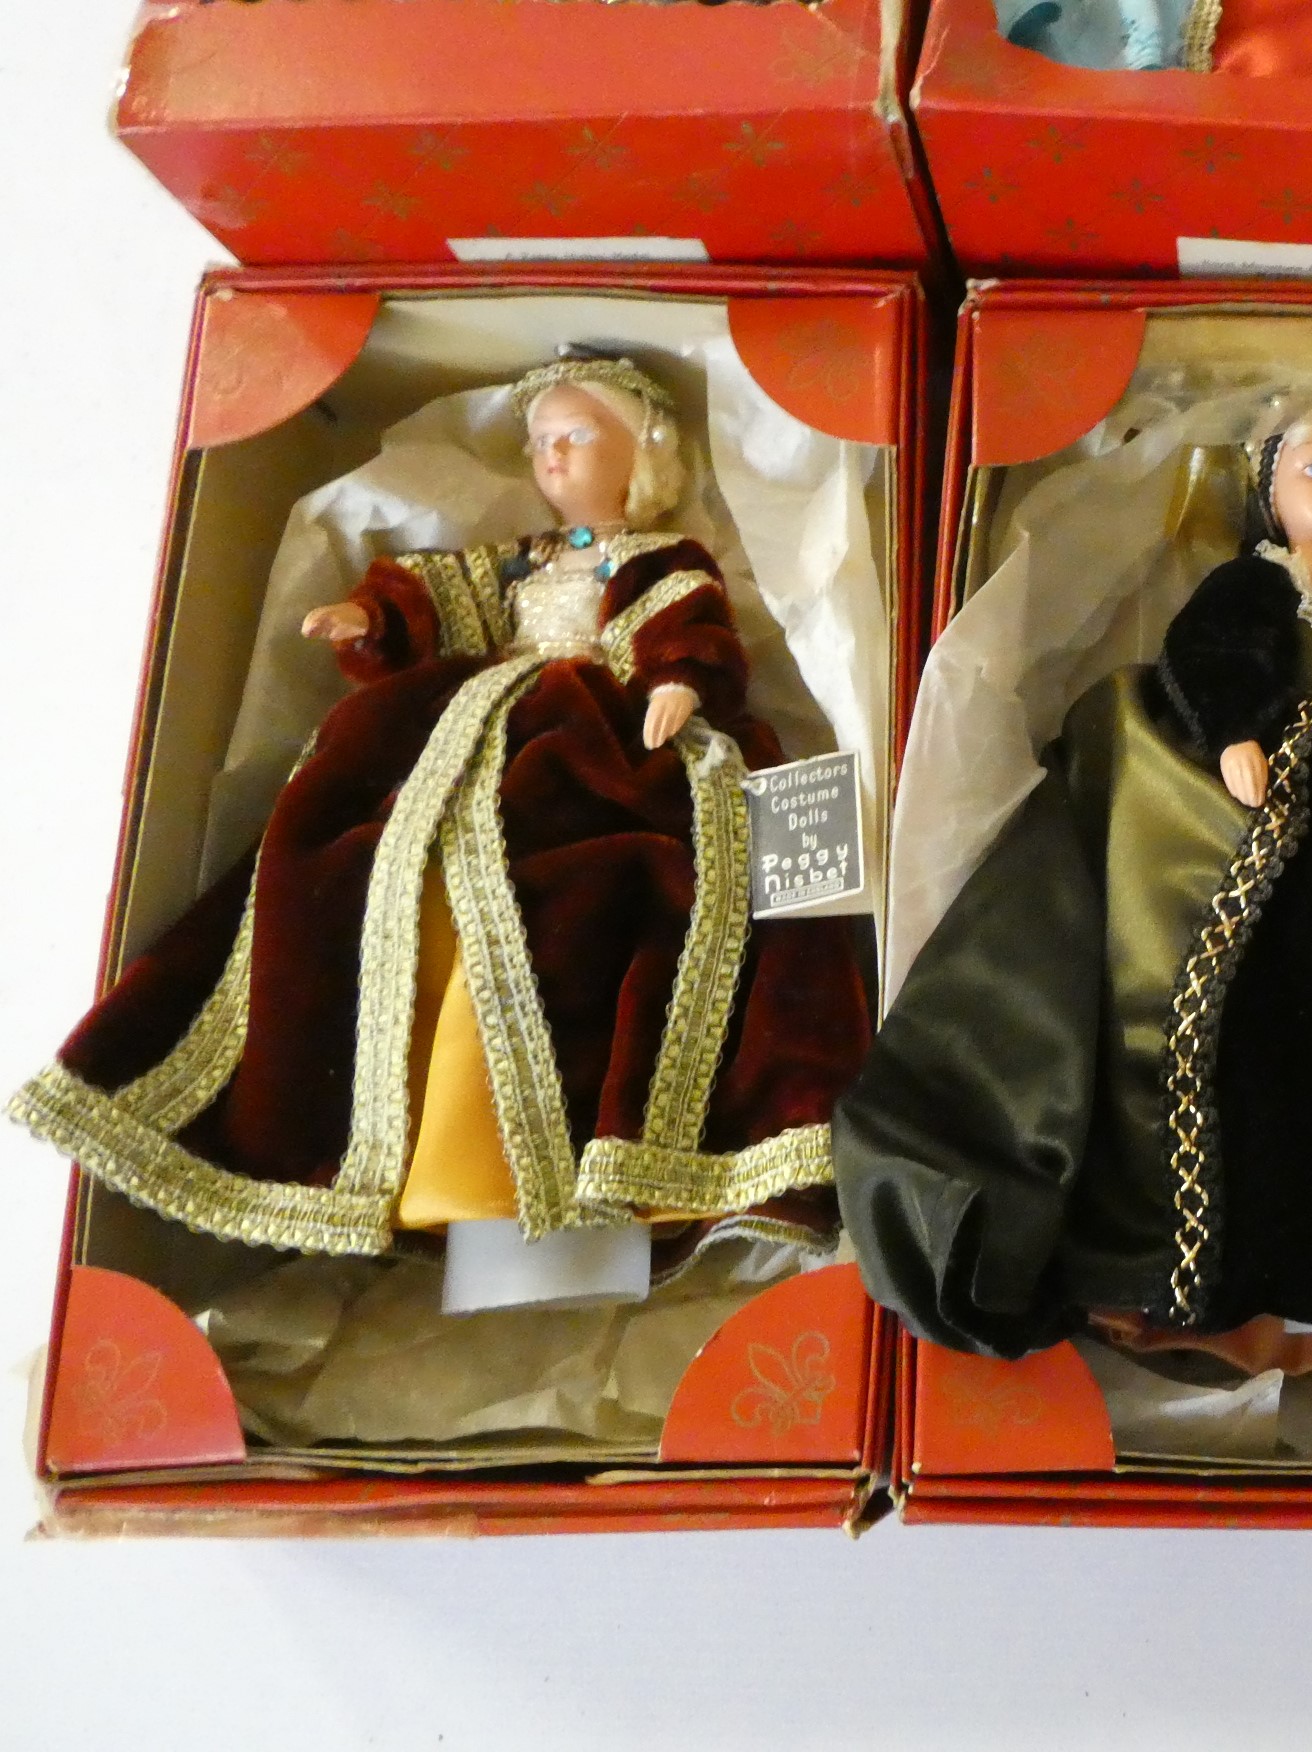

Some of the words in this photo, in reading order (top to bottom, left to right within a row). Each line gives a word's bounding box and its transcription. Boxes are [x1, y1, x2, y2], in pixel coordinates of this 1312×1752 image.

[769, 763, 848, 793] Collectors
[771, 786, 839, 814] Costume
[788, 808, 828, 831] Dolls
[802, 832, 818, 850] by
[761, 843, 848, 873] Peggy
